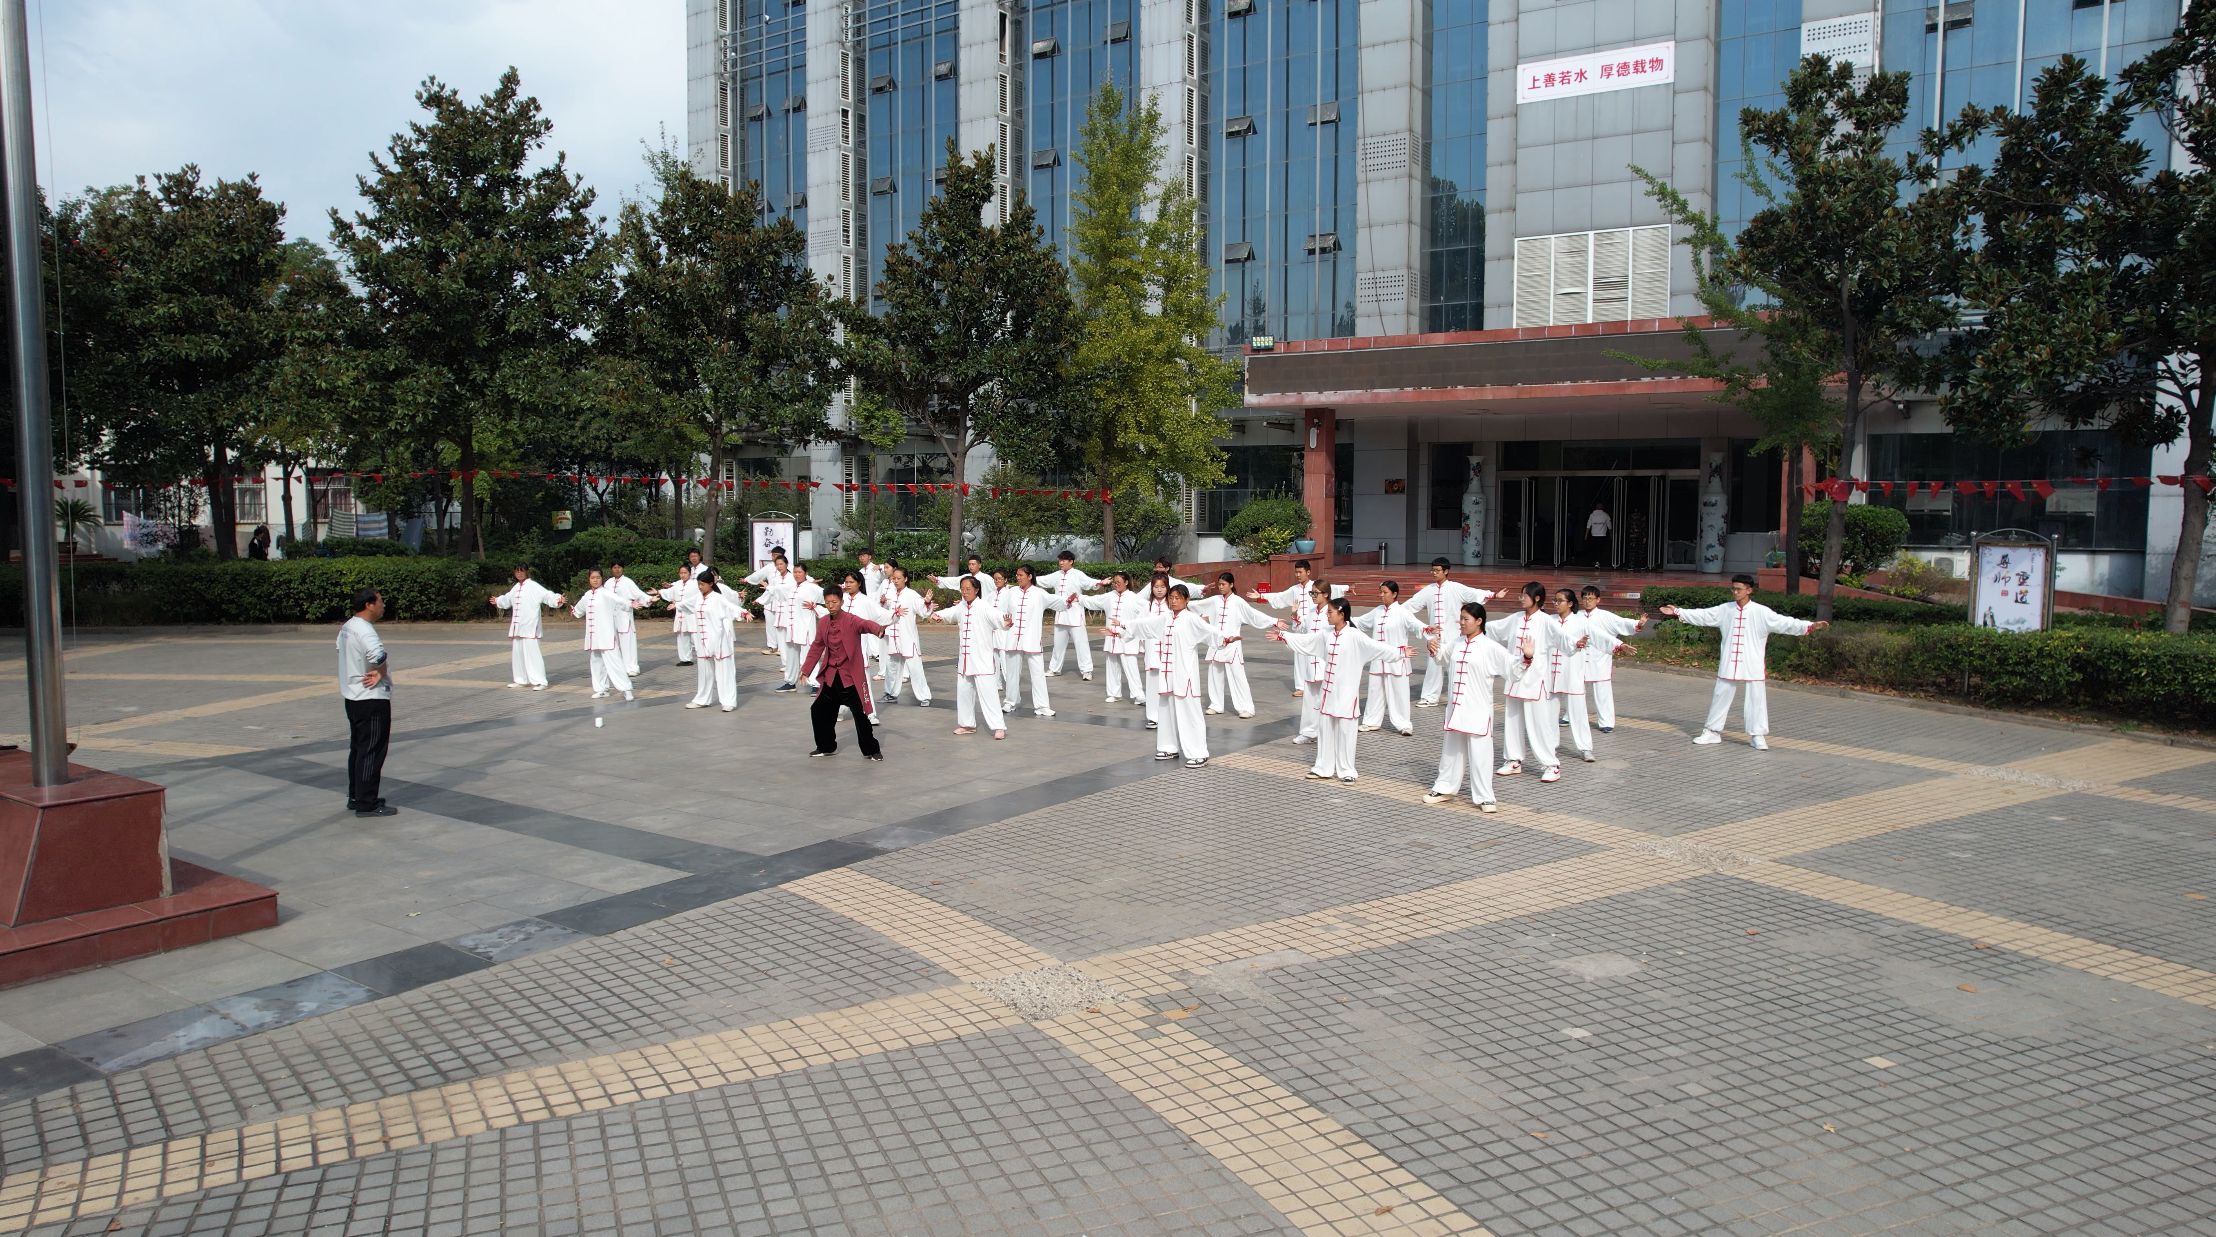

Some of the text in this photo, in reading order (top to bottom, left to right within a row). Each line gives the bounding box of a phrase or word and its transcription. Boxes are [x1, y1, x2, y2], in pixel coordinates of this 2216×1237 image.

[1528, 57, 1664, 90] 上善若水 厚德载物
